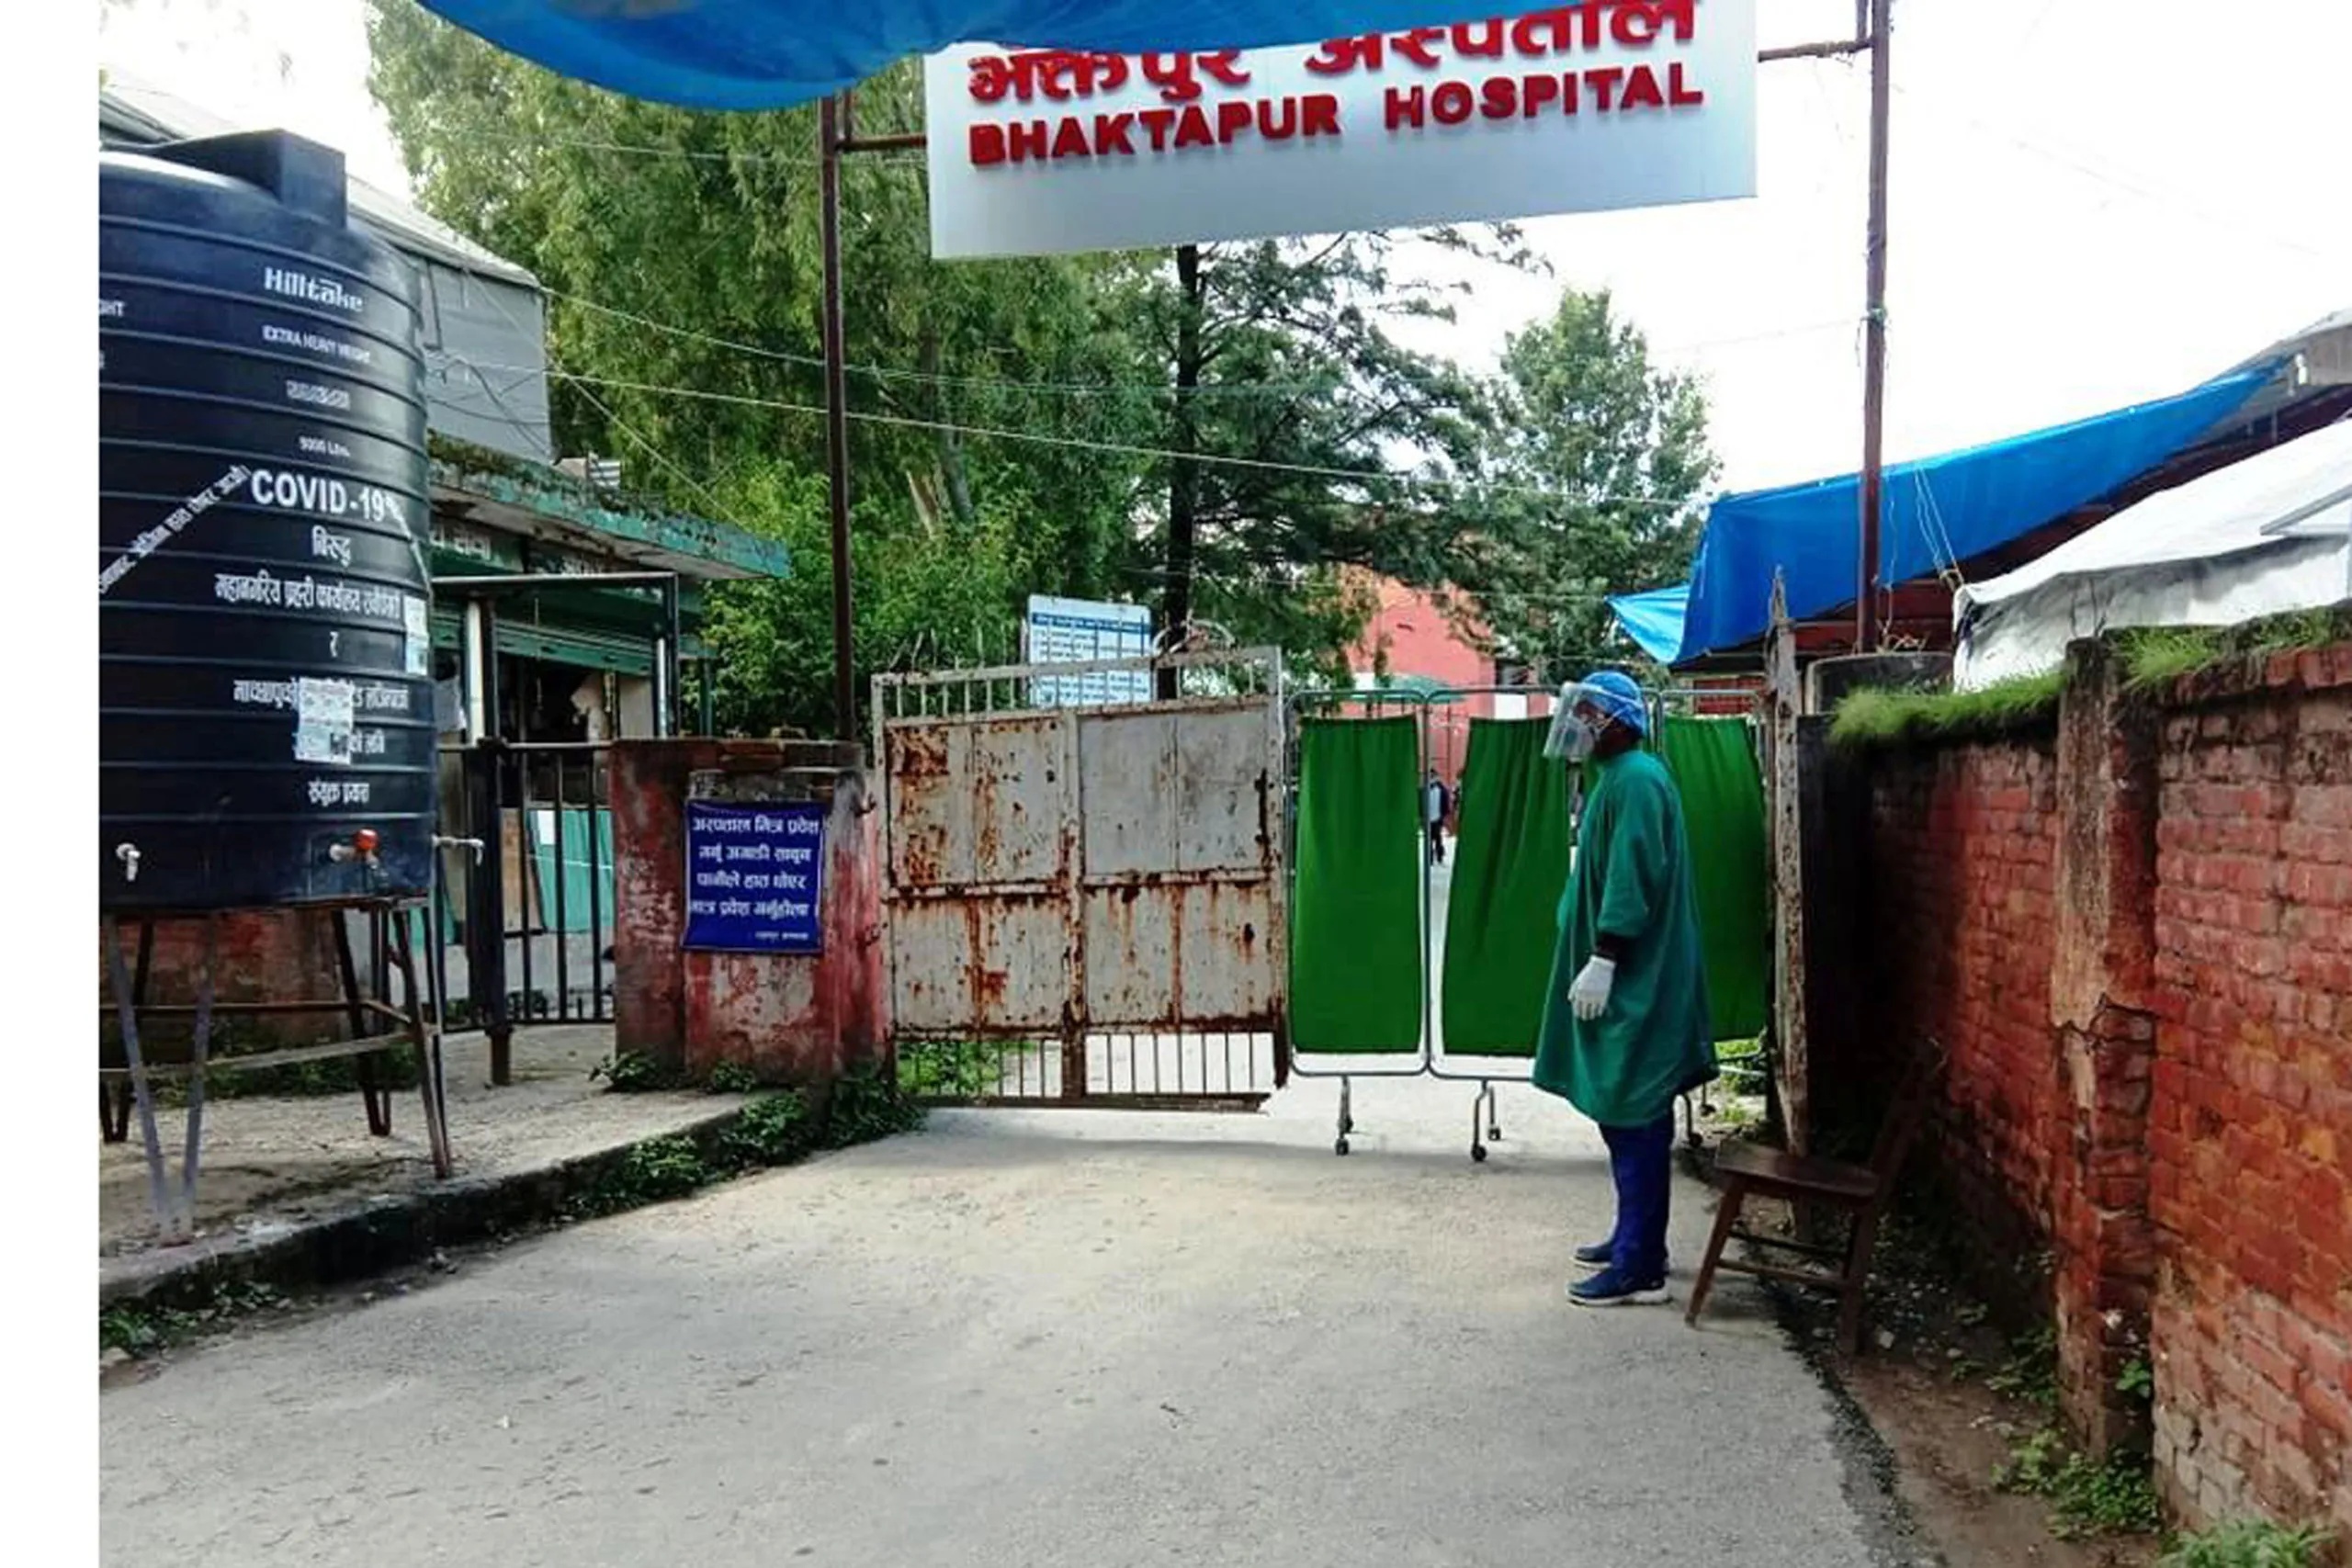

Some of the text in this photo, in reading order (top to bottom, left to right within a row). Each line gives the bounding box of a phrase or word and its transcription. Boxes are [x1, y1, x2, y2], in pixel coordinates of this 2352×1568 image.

[969, 62, 1703, 165] BHAKTAPUR HOSPITAL
[265, 266, 364, 312] Hilltake
[251, 468, 385, 522] COVID-19
